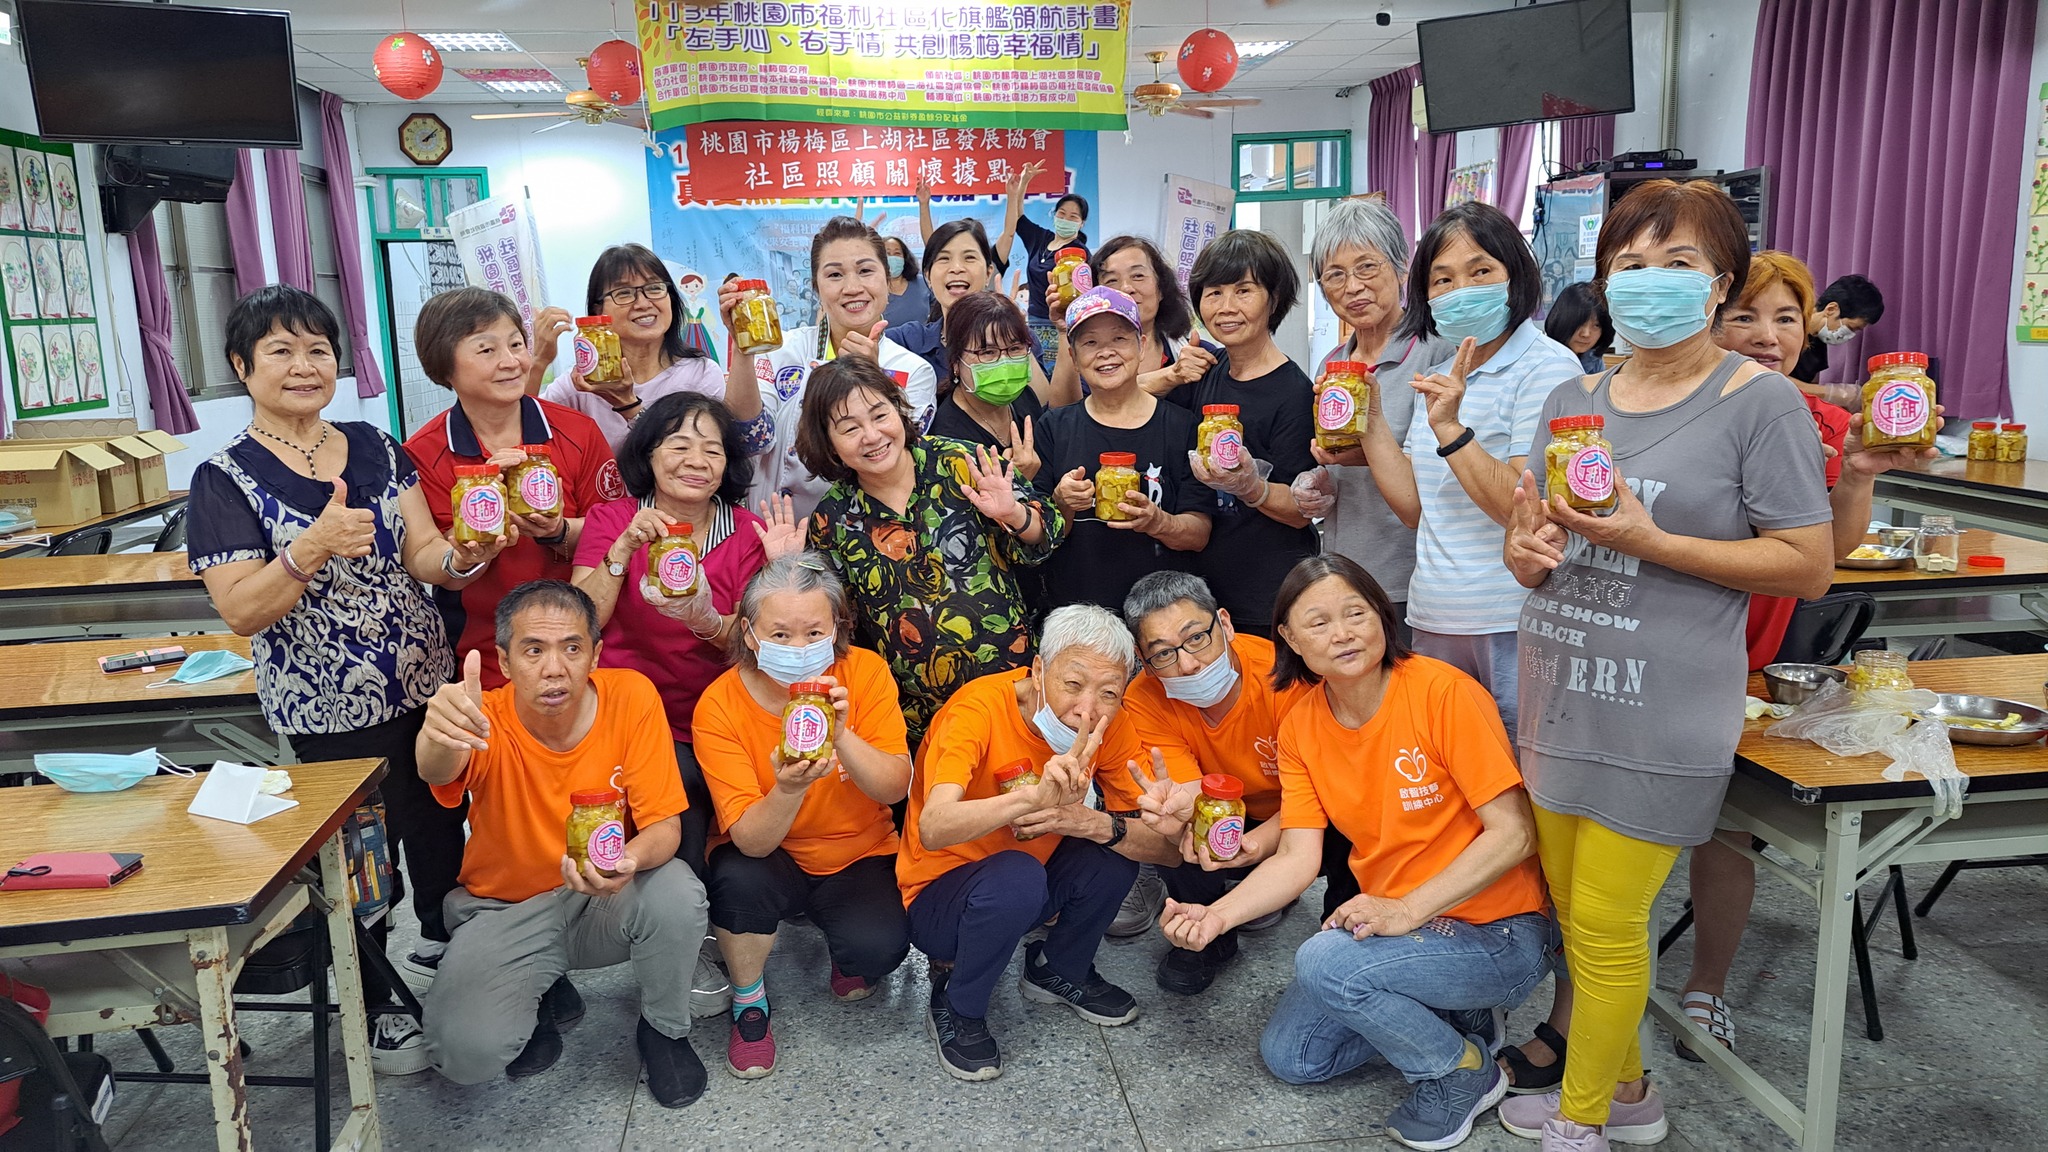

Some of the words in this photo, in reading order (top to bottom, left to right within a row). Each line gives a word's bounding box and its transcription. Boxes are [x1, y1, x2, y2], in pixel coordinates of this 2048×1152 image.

[699, 127, 1053, 156] 桃園市楊梅區上湖社區發展協會
[744, 157, 1012, 190] 社區照顧關懷據點
[1527, 594, 1559, 614] SIDE
[1560, 603, 1641, 632] SHOW
[1520, 614, 1587, 648] MARCH
